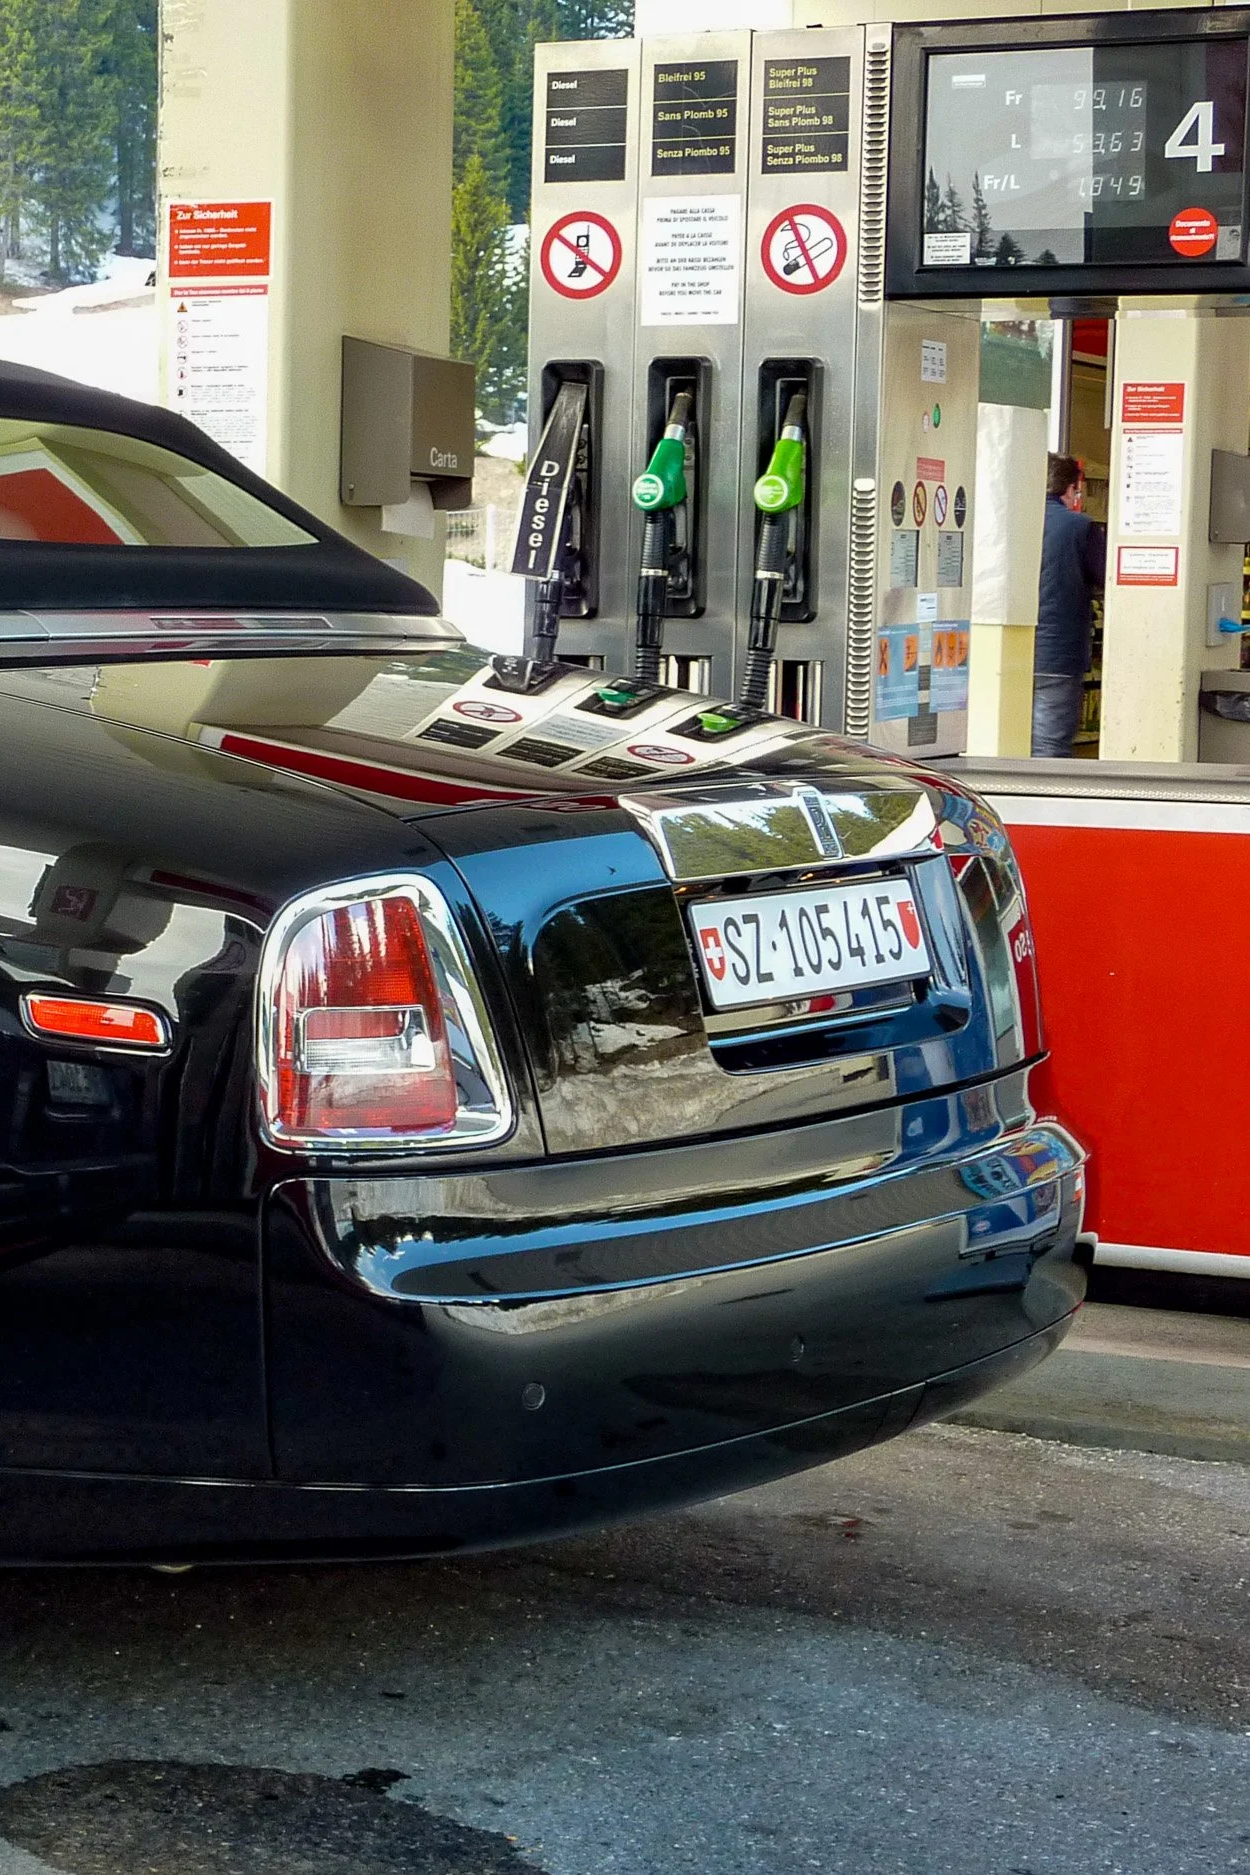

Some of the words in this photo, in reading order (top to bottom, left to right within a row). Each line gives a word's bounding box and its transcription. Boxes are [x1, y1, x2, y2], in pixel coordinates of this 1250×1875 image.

[658, 71, 692, 83] Bleifrei
[693, 71, 706, 81] 95
[769, 67, 795, 79] Super
[797, 66, 817, 77] Plus
[551, 79, 578, 90] Diesel
[769, 78, 802, 89] Bleifrei
[802, 77, 813, 87] 98
[1005, 90, 1023, 105] Fr
[657, 110, 682, 121] Sans
[684, 108, 715, 120] Plomb
[716, 108, 728, 118] 95
[768, 105, 794, 117] Super
[796, 104, 816, 115] Plus
[550, 116, 577, 127] Diesel
[768, 117, 792, 128] Sans
[794, 115, 822, 127] Plomb
[823, 115, 834, 125] 98
[1011, 133, 1021, 149] L
[1164, 100, 1225, 173] 4
[656, 147, 682, 158] Senza
[683, 146, 718, 158] Piombo
[718, 145, 730, 155] 95
[767, 143, 793, 156] Super
[795, 143, 815, 153] Plus
[549, 153, 576, 164] Diesel
[766, 154, 792, 166] Senza
[794, 153, 829, 165] Piombo
[830, 153, 842, 164] 98
[983, 173, 1021, 191] Fr/L
[176, 210, 192, 220] Zur
[193, 209, 238, 220] Sicherheit
[430, 447, 458, 468] Carta
[528, 460, 560, 569] Diesel
